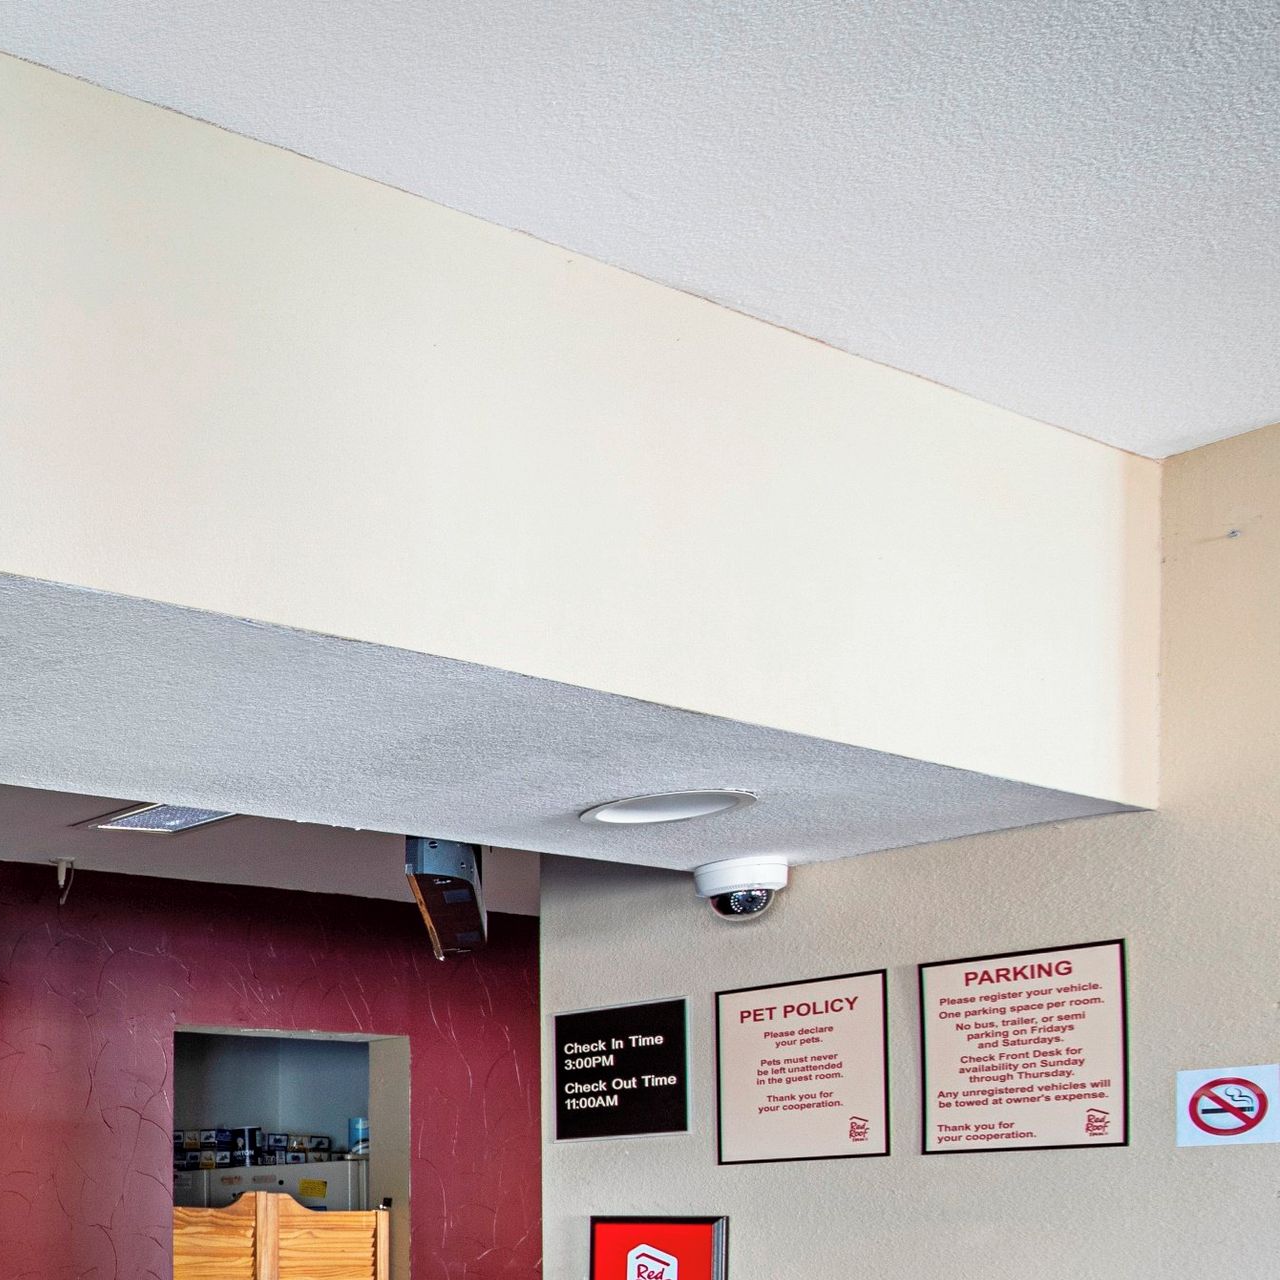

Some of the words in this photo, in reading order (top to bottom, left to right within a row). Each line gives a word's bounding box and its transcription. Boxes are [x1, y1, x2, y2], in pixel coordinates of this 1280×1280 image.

[965, 960, 1073, 986] PARKING
[939, 997, 976, 1006] Please
[979, 990, 1023, 1002] register
[1026, 987, 1053, 998] your
[1057, 982, 1102, 993] vehicle.
[740, 1006, 777, 1023] PET
[783, 997, 859, 1018] POLICY
[939, 1010, 961, 1019] One
[965, 1007, 1006, 1018] parking
[1010, 1003, 1044, 1013] space
[1047, 1000, 1066, 1010] per
[1070, 996, 1104, 1006] room.
[956, 1022, 971, 1031] No
[974, 1020, 998, 1029] bus,
[1002, 1016, 1038, 1026] trailer,
[1042, 1013, 1053, 1022] or
[1057, 1012, 1085, 1020] semi
[764, 1030, 795, 1039] Please
[798, 1026, 833, 1035] declare
[967, 1030, 1008, 1041] parking
[1013, 1028, 1027, 1036] on
[1031, 1023, 1074, 1033] Fridays
[564, 1040, 606, 1054] Check
[611, 1038, 624, 1050] In
[629, 1035, 664, 1047] Time
[775, 1039, 797, 1048] your
[800, 1036, 823, 1046] pets.
[978, 1040, 998, 1049] and
[1002, 1035, 1064, 1047] Saturdays.
[564, 1054, 614, 1070] 3:00PM
[761, 1058, 781, 1066] Pets
[784, 1056, 808, 1064] must
[810, 1053, 838, 1061] never
[960, 1054, 995, 1064] Check
[999, 1052, 1030, 1061] Front
[1033, 1049, 1062, 1058] Desk
[1066, 1047, 1083, 1056] for
[788, 1062, 843, 1073] unattended
[958, 1061, 1018, 1074] availability
[1022, 1061, 1037, 1069] on
[1040, 1058, 1085, 1067] Sunday
[785, 1074, 812, 1084] guest
[815, 1072, 844, 1080] room.
[969, 1074, 1013, 1083] through
[1017, 1069, 1075, 1079] Thursday.
[564, 1080, 607, 1094] Check
[612, 1077, 637, 1090] Out
[641, 1075, 677, 1087] Time
[937, 1091, 958, 1099] Any
[962, 1085, 1034, 1097] unregistered
[1038, 1082, 1086, 1092] vehicles
[1090, 1079, 1111, 1088] will
[564, 1094, 618, 1110] 11:00AM
[767, 1094, 796, 1102] Thank
[799, 1092, 816, 1102] you
[939, 1100, 952, 1108] be
[955, 1098, 988, 1107] towed
[1006, 1094, 1051, 1104] owner's
[1054, 1091, 1109, 1102] expense.
[758, 1105, 780, 1114] your
[783, 1100, 844, 1110] cooperation.
[1088, 1114, 1105, 1123] Red
[937, 1124, 971, 1133] Thank
[974, 1123, 995, 1132] you
[998, 1121, 1015, 1129] for
[937, 1134, 962, 1144] your
[966, 1131, 1037, 1142] cooperation.
[637, 1264, 665, 1280] Red
